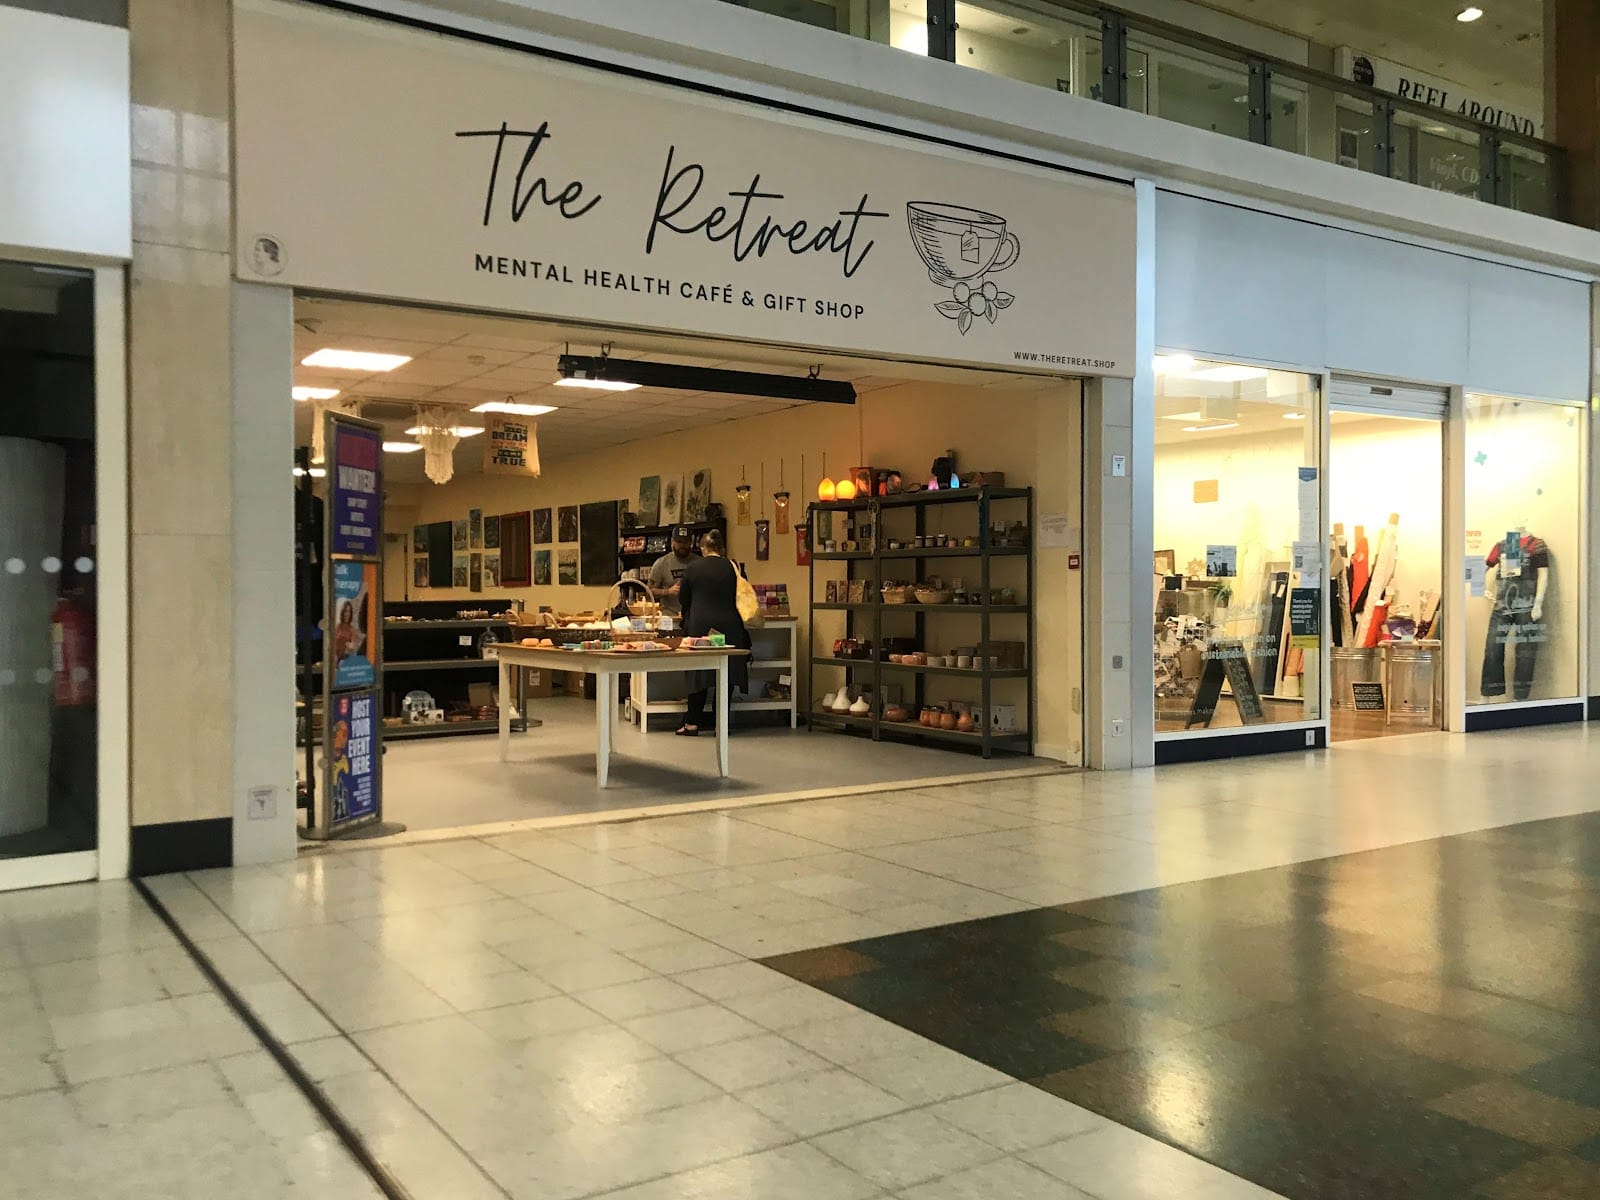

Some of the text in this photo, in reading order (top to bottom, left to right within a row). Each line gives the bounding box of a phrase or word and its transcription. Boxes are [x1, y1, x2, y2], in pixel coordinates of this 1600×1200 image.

[455, 121, 890, 278] The Retreat
[475, 254, 865, 320] MENTAL HEALTH CAFÉ & GIFT SHOP
[1013, 351, 1116, 369] WWW.THERETREAT.SHOP
[492, 431, 528, 443] DREAM
[491, 456, 526, 467] TRUE
[351, 699, 370, 719] HOST
[351, 718, 371, 738] YOUR
[348, 737, 371, 758] EVENT
[351, 755, 371, 776] HERE
